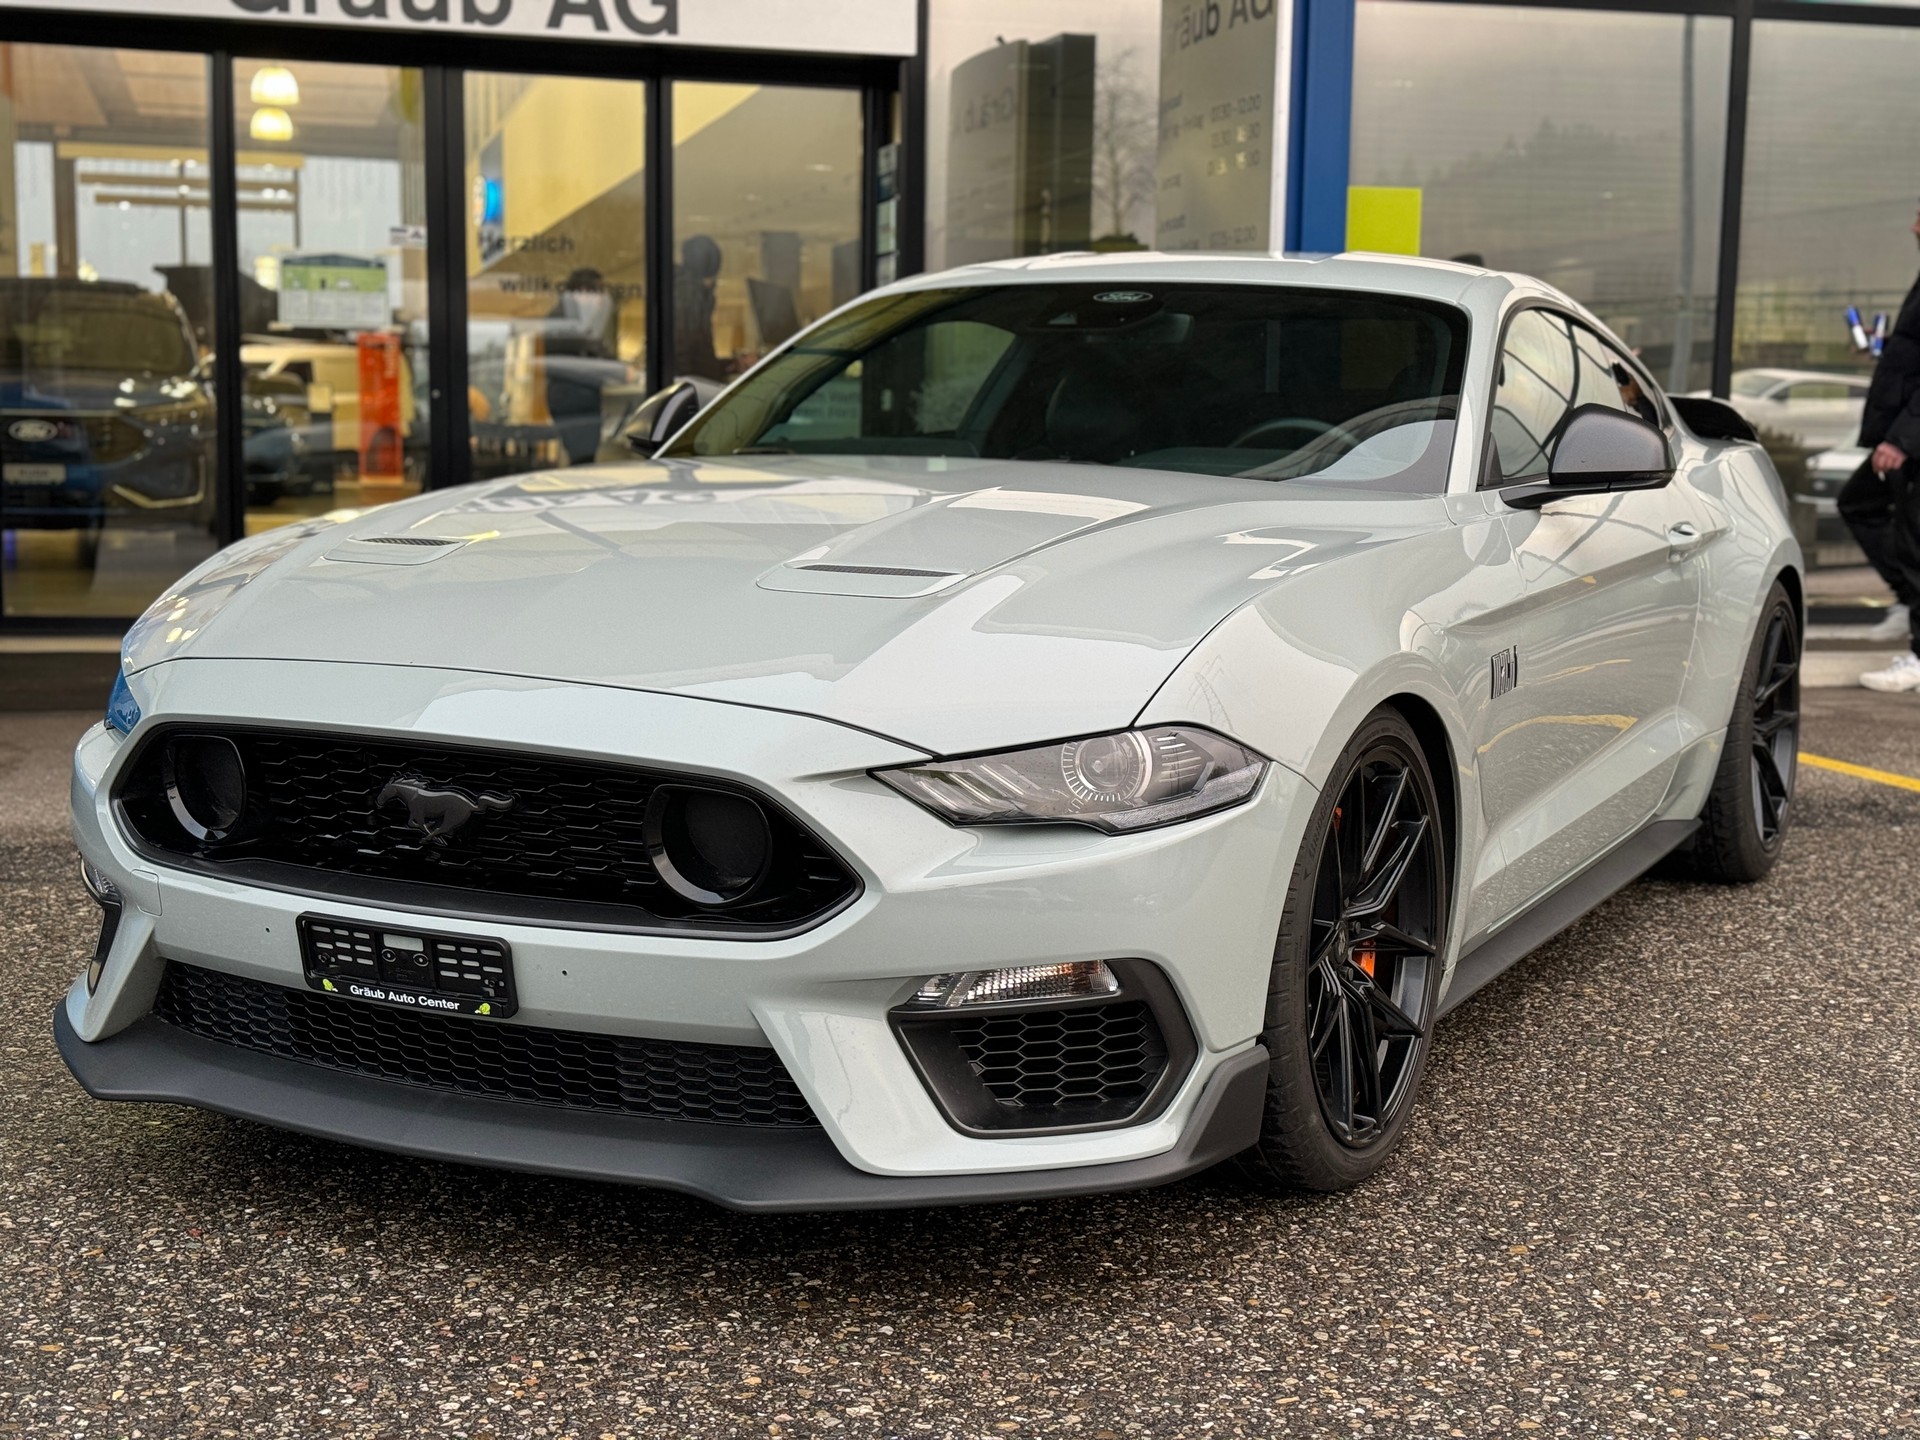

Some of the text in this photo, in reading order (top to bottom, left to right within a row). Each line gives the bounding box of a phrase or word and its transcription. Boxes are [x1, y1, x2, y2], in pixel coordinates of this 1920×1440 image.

[350, 985, 460, 1010] Gräub Auto Center
